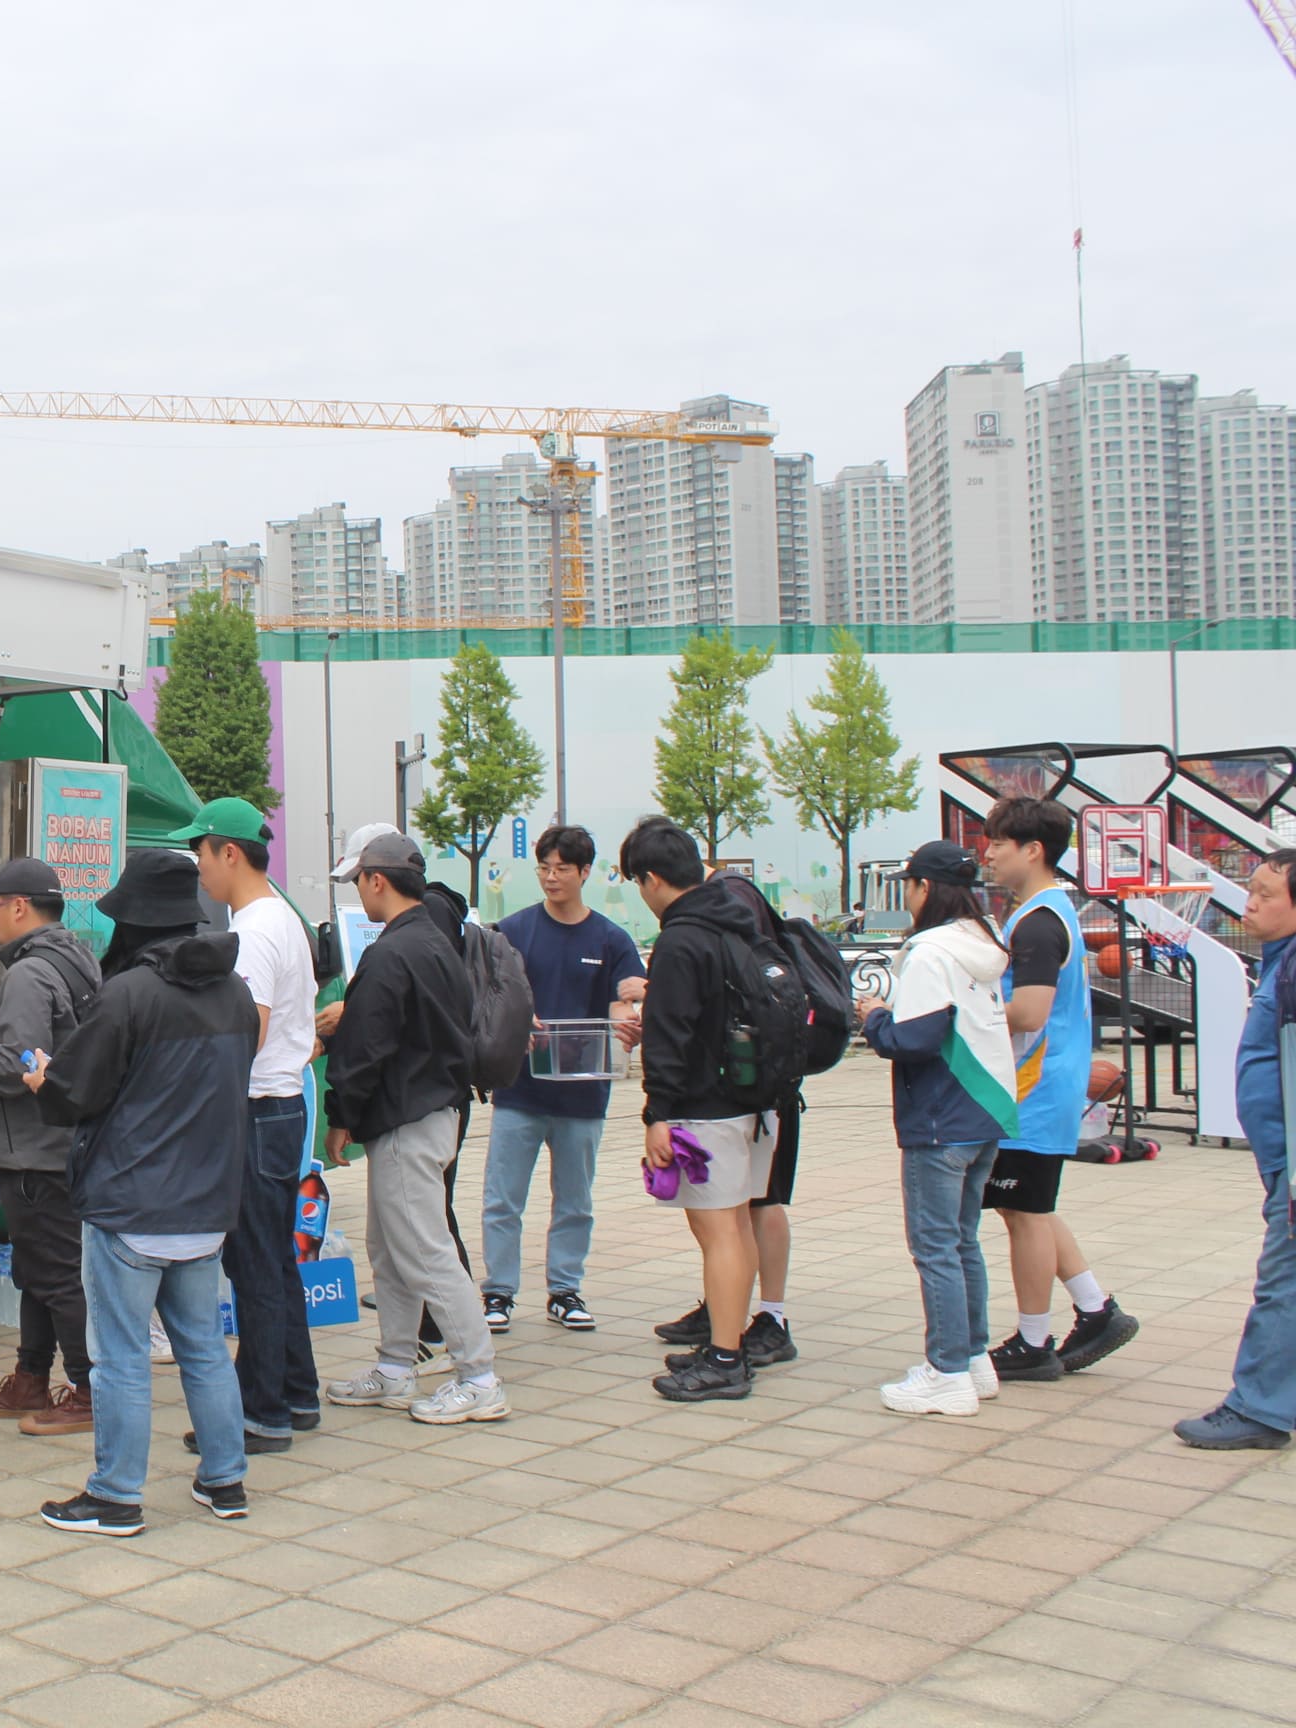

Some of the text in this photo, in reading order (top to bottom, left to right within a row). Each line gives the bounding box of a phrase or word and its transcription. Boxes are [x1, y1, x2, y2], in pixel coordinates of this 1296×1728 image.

[47, 814, 112, 841] BOBAE
[46, 841, 111, 866] NANUM
[303, 1277, 342, 1309] epsi
